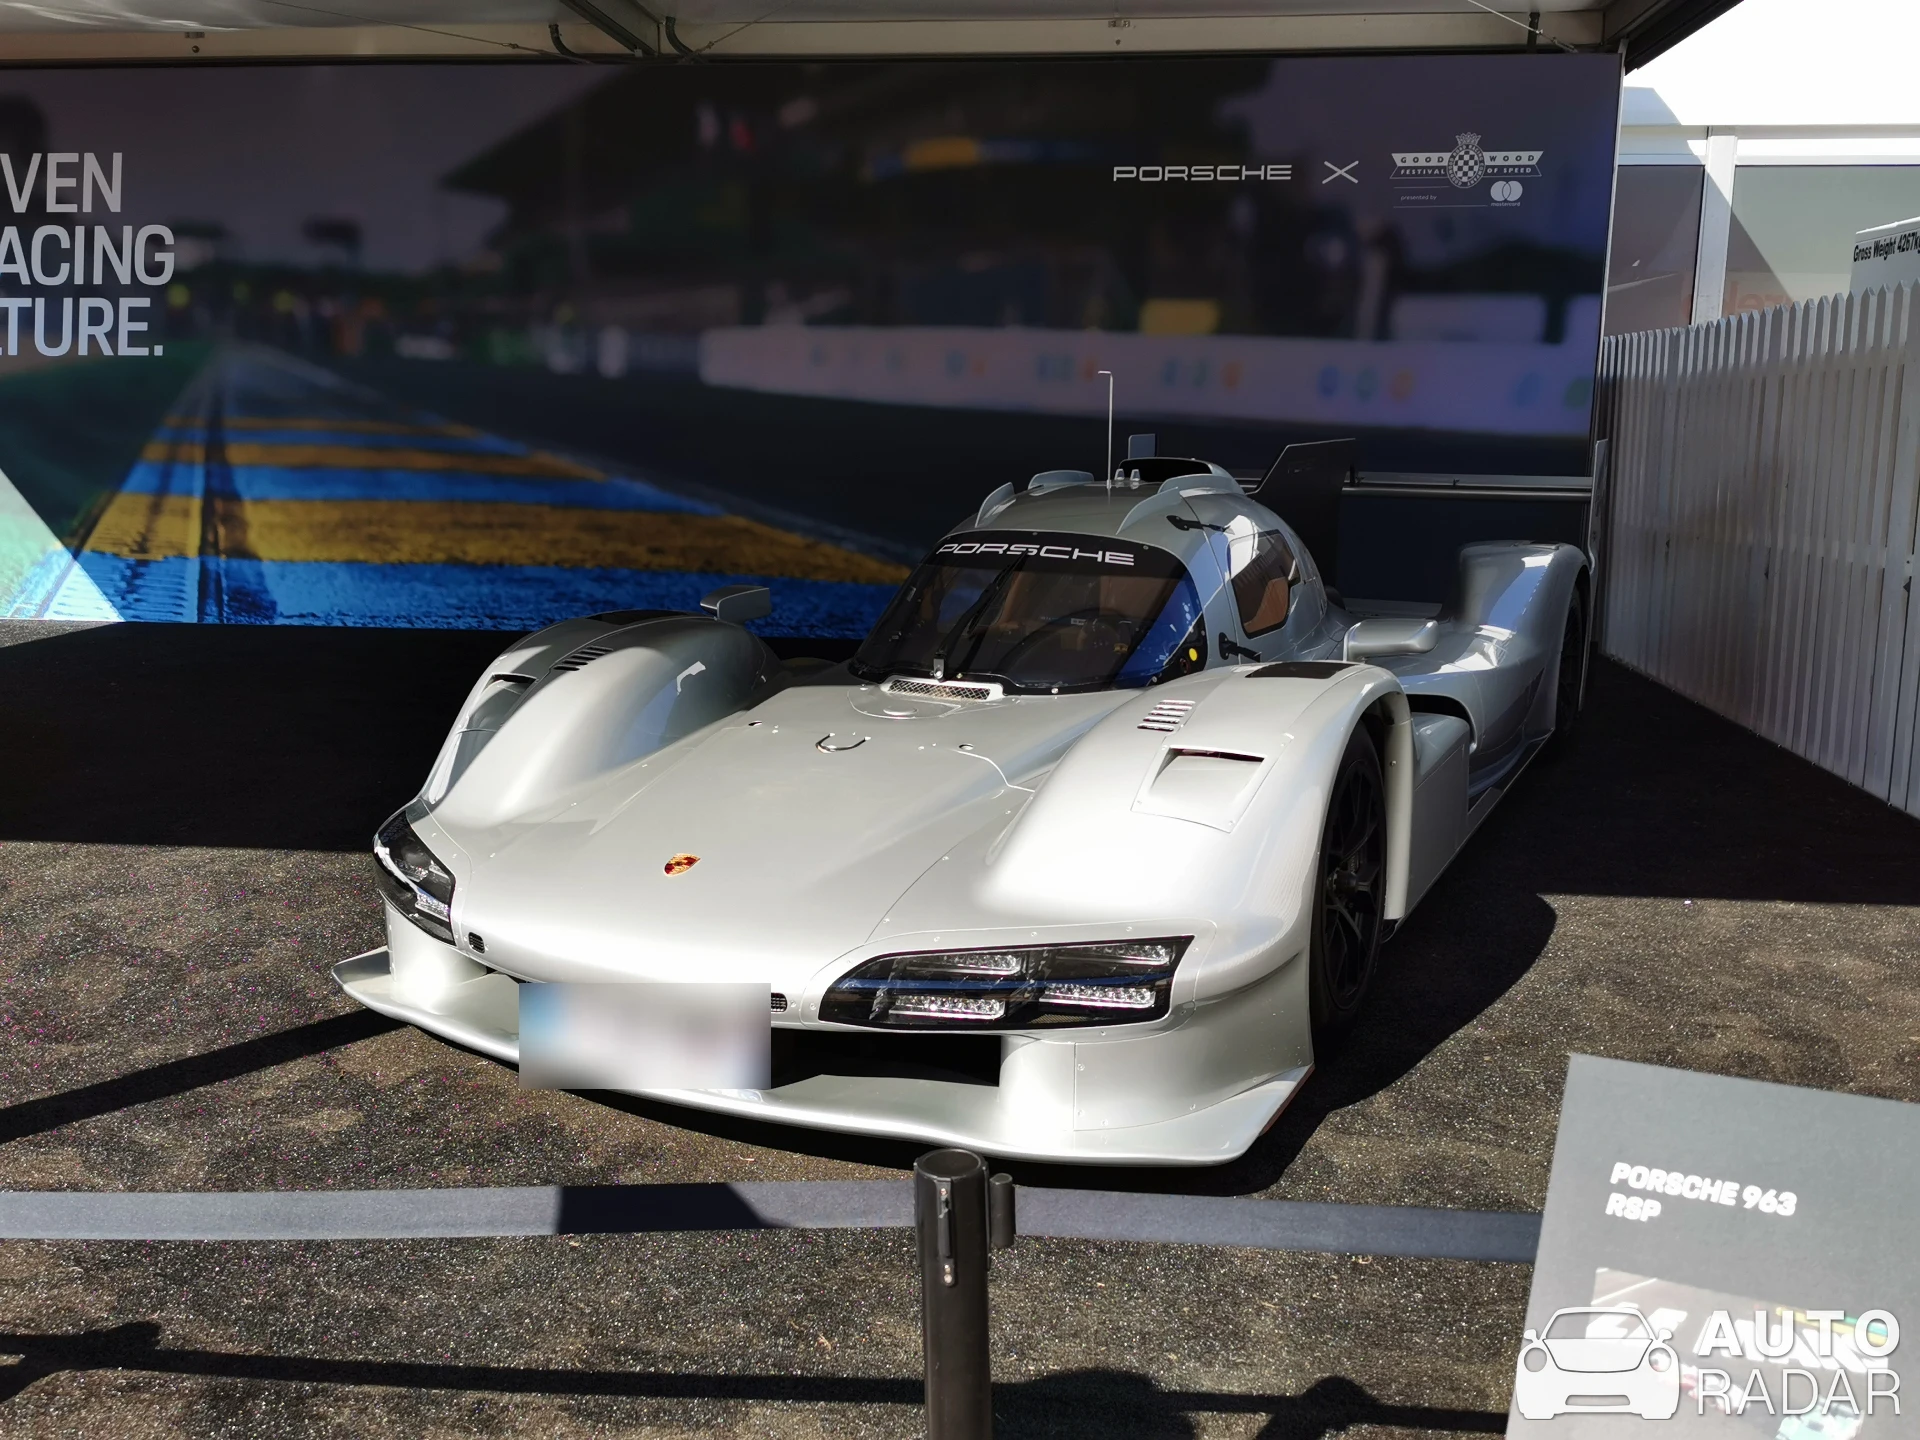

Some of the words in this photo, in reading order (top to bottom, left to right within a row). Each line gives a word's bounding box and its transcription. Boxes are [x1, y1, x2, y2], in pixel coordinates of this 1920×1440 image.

[1489, 154, 1535, 162] WOOD
[0, 152, 123, 213] VEN
[1113, 165, 1293, 181] PORSCHE
[1853, 244, 1872, 262] Gross
[1873, 236, 1896, 261] Weight
[0, 297, 164, 356] TURE.
[936, 543, 1135, 566] PORSCHE
[1610, 1162, 1739, 1206] PORSCHE
[1741, 1185, 1798, 1217] 963
[1605, 1192, 1662, 1222] RSP
